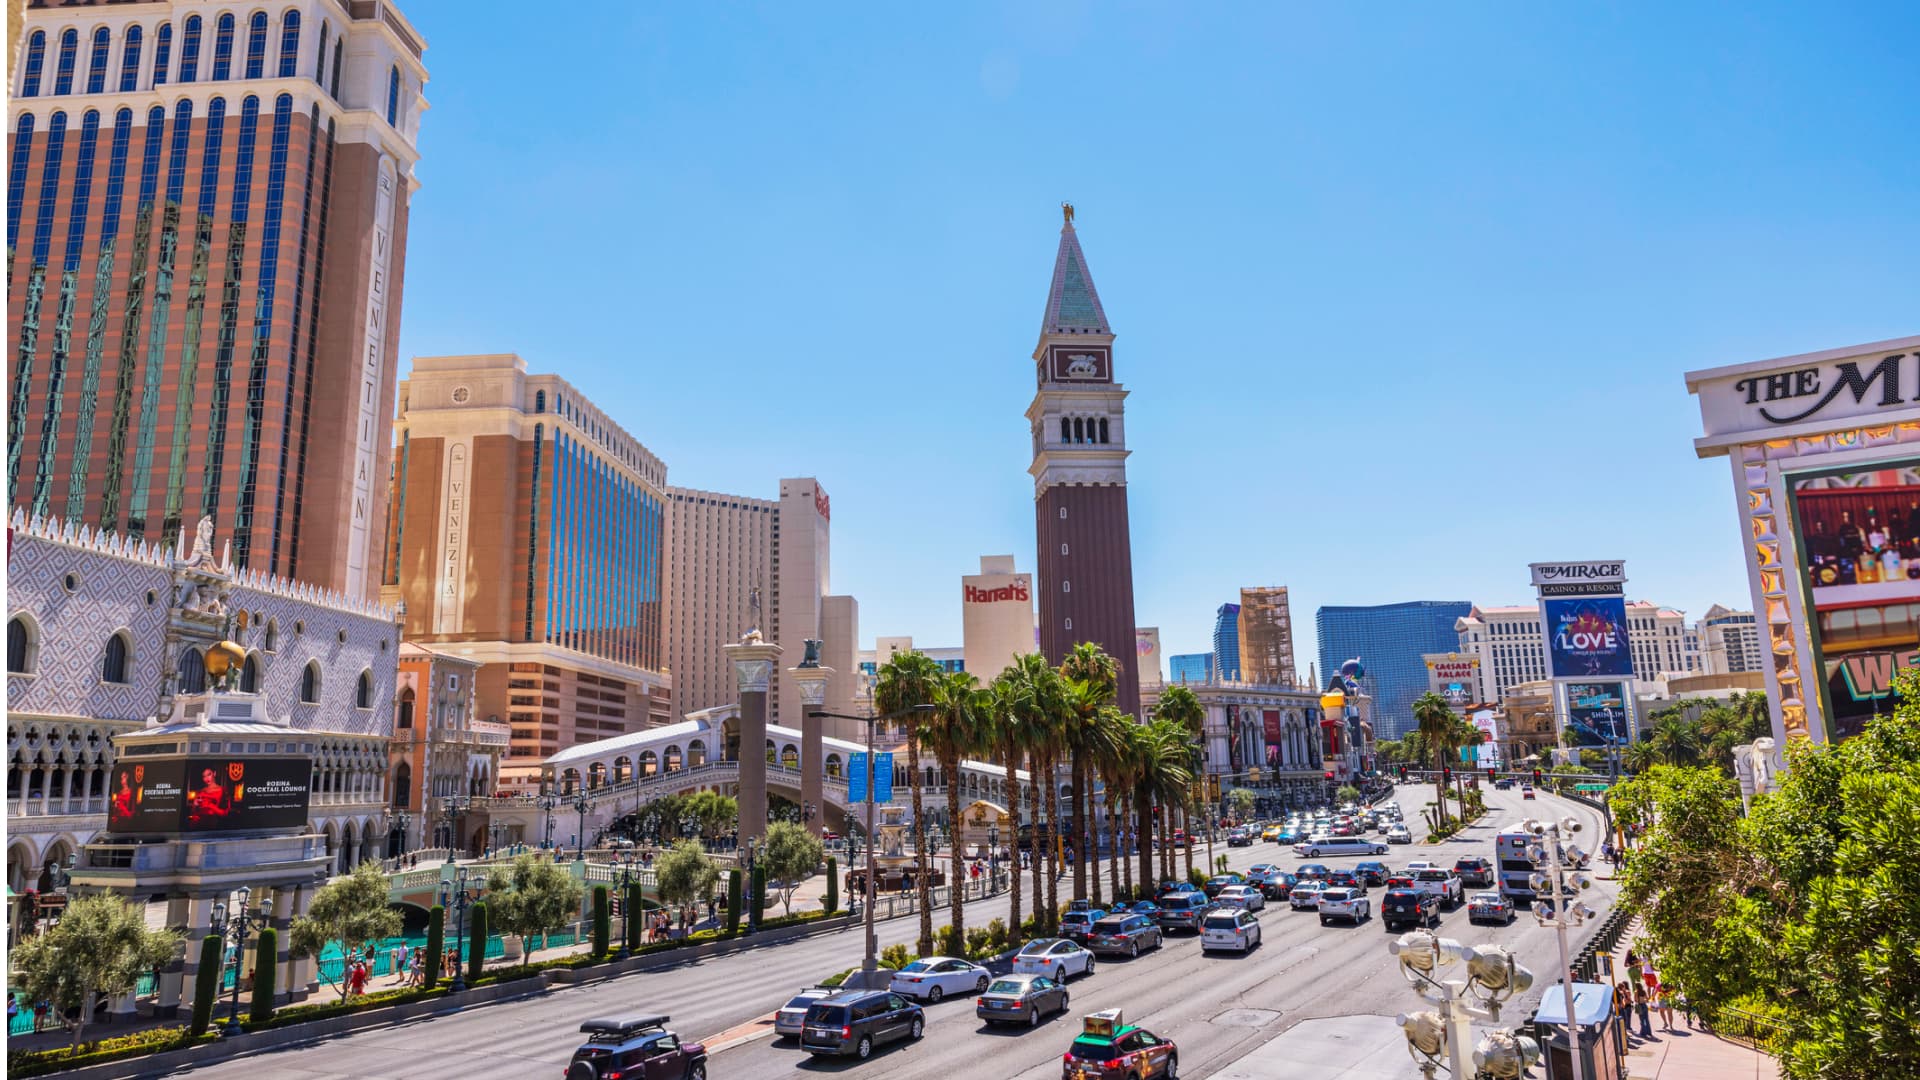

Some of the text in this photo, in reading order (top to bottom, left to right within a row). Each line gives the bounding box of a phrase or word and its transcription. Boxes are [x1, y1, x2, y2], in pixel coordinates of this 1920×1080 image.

[355, 231, 387, 519] VENETIAN
[1736, 368, 1821, 404] THE
[446, 483, 462, 594] VENEZIA
[1544, 564, 1621, 579] MIRAGE
[1543, 585, 1577, 593] CASINO
[1586, 584, 1620, 592] RESORT
[1561, 632, 1617, 650] LOVE
[1437, 670, 1472, 678] PALACE
